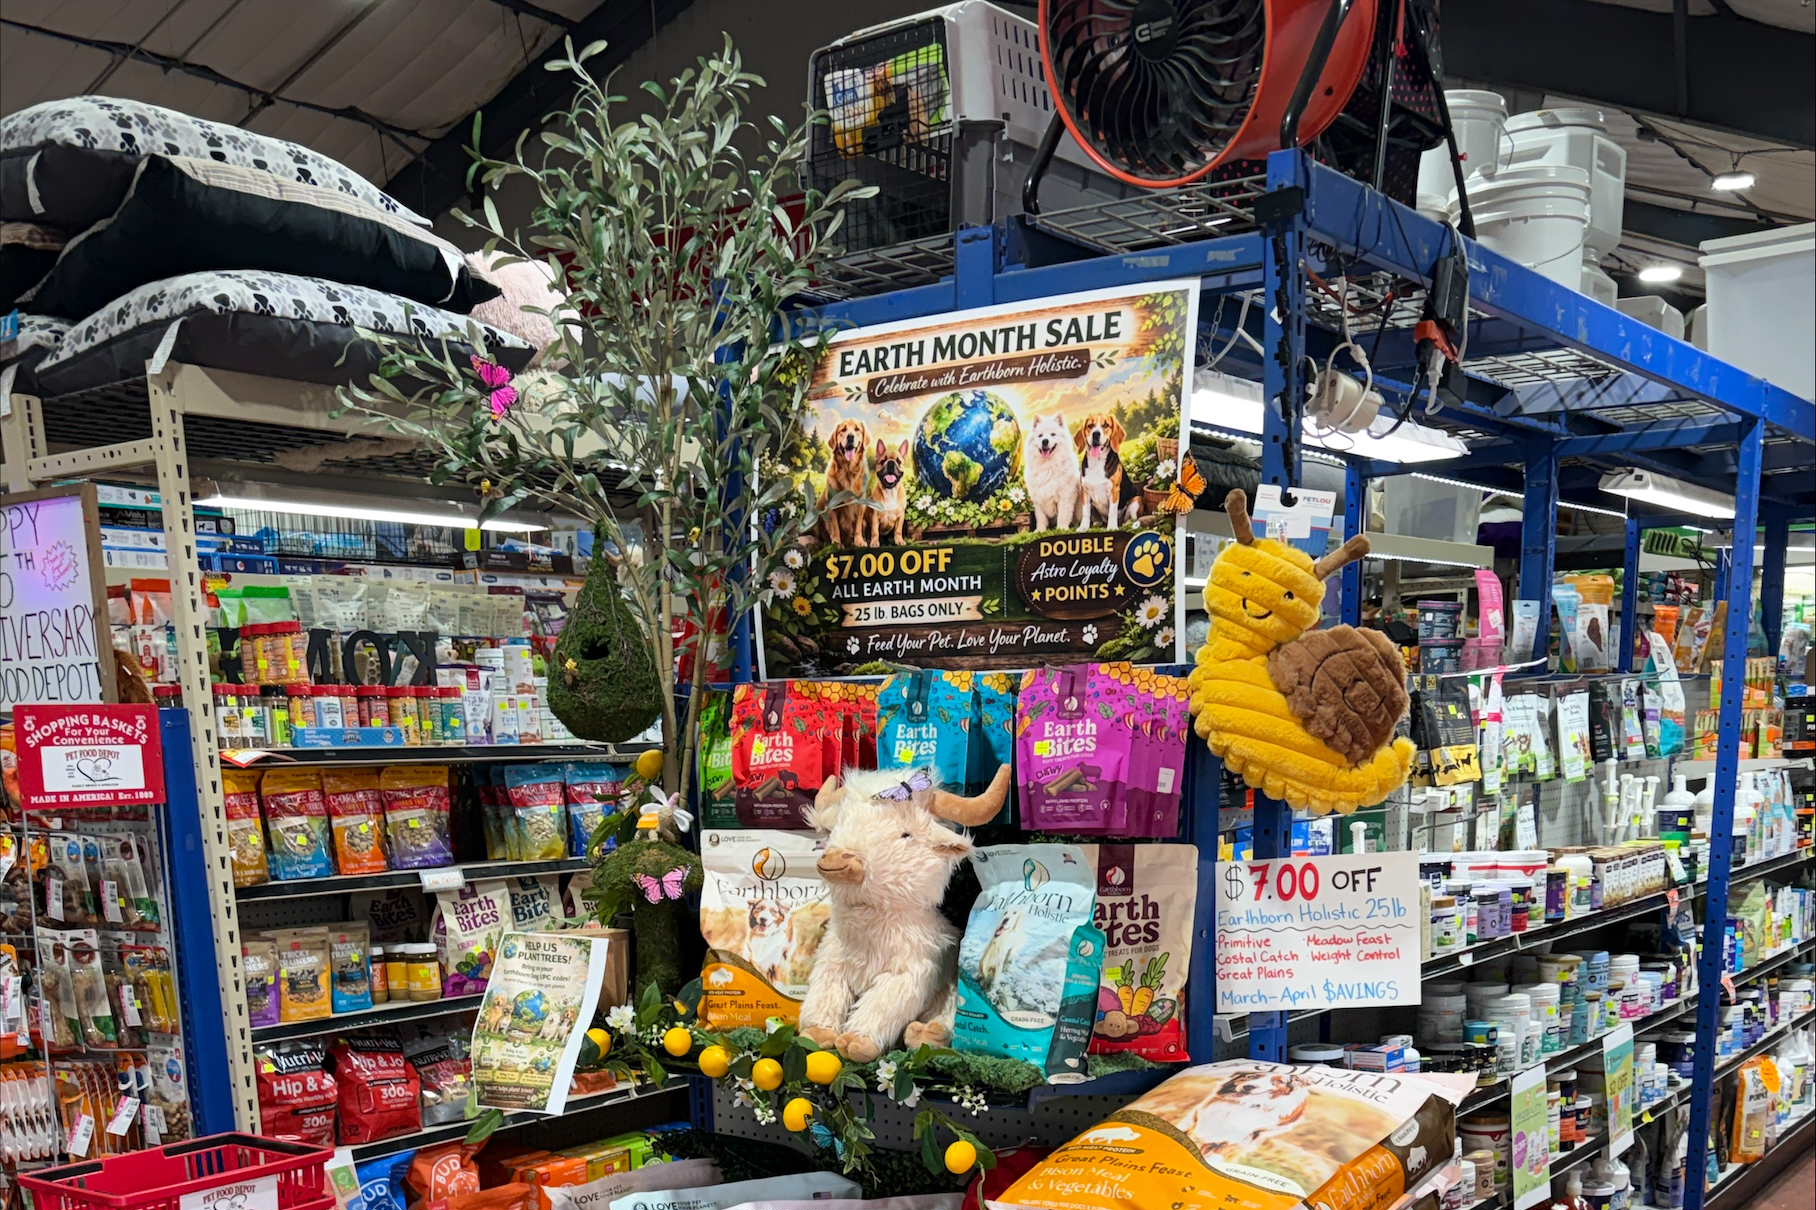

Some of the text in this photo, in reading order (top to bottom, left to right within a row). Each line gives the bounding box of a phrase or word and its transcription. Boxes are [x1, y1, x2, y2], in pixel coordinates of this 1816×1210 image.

[839, 311, 1122, 377] EARTH MONTH SALE
[874, 375, 929, 397] Celebrate
[930, 371, 957, 389] with
[958, 362, 1025, 386] Earthborn
[1303, 496, 1331, 504] PETLOU
[1039, 536, 1114, 558] DOUBLE
[826, 548, 953, 583] $7.00 OFF
[1030, 557, 1119, 585] Astro Loyalty
[832, 575, 982, 599] ALL EARTH MONTH
[1045, 583, 1109, 602] POINTS
[854, 607, 871, 621] 25
[891, 603, 924, 619] BAGS
[928, 602, 963, 617] ONLY
[867, 624, 1070, 658] Feed Your Pet. Love Your Planet.
[25, 714, 148, 748] SHOPPING BASKETS
[65, 727, 110, 736] For Your
[896, 724, 937, 740] Earth
[1044, 719, 1097, 738] Earth
[52, 735, 124, 745] Convenience
[754, 731, 793, 748] Earth
[1042, 737, 1097, 758] Bites
[65, 749, 120, 761] PET FOOD DEPOT
[751, 748, 793, 766] Bites
[894, 740, 937, 759] Bites
[30, 795, 57, 804] MADE
[59, 794, 69, 802] IN
[72, 792, 114, 802] AMERICA!
[717, 879, 827, 900] Earthborn
[1332, 867, 1382, 893] OFF
[452, 896, 497, 916] Earth
[1029, 905, 1068, 924] Holistic
[1218, 909, 1294, 926] Earthborn
[1299, 902, 1360, 922] Holistic
[457, 909, 499, 933] Bites
[525, 941, 557, 953] HELP US
[1218, 935, 1271, 949] Primitive
[1306, 932, 1392, 947] Meadow Feast
[282, 950, 310, 959] TRICKY
[518, 952, 572, 964] PLANT TREES!
[1108, 944, 1160, 958] TREATS FOR DOGS
[1218, 951, 1299, 965] Costal Catch
[1311, 948, 1400, 965] Weight Control
[1217, 965, 1294, 981] Great Plains
[1323, 978, 1399, 1003] $AVINGS
[708, 1000, 728, 1009] Great
[730, 1000, 754, 1009] Plains
[351, 1055, 388, 1068] Hip &
[272, 1078, 318, 1096] Hip &
[1312, 1077, 1389, 1104] Holistic
[1054, 1155, 1097, 1164] Great
[1099, 1155, 1145, 1172] Plains
[1225, 1167, 1291, 1188] GRAIN-FREE
[203, 1185, 256, 1204] PET FOOD DEPOT
[1027, 1180, 1136, 1200] & Vegetables
